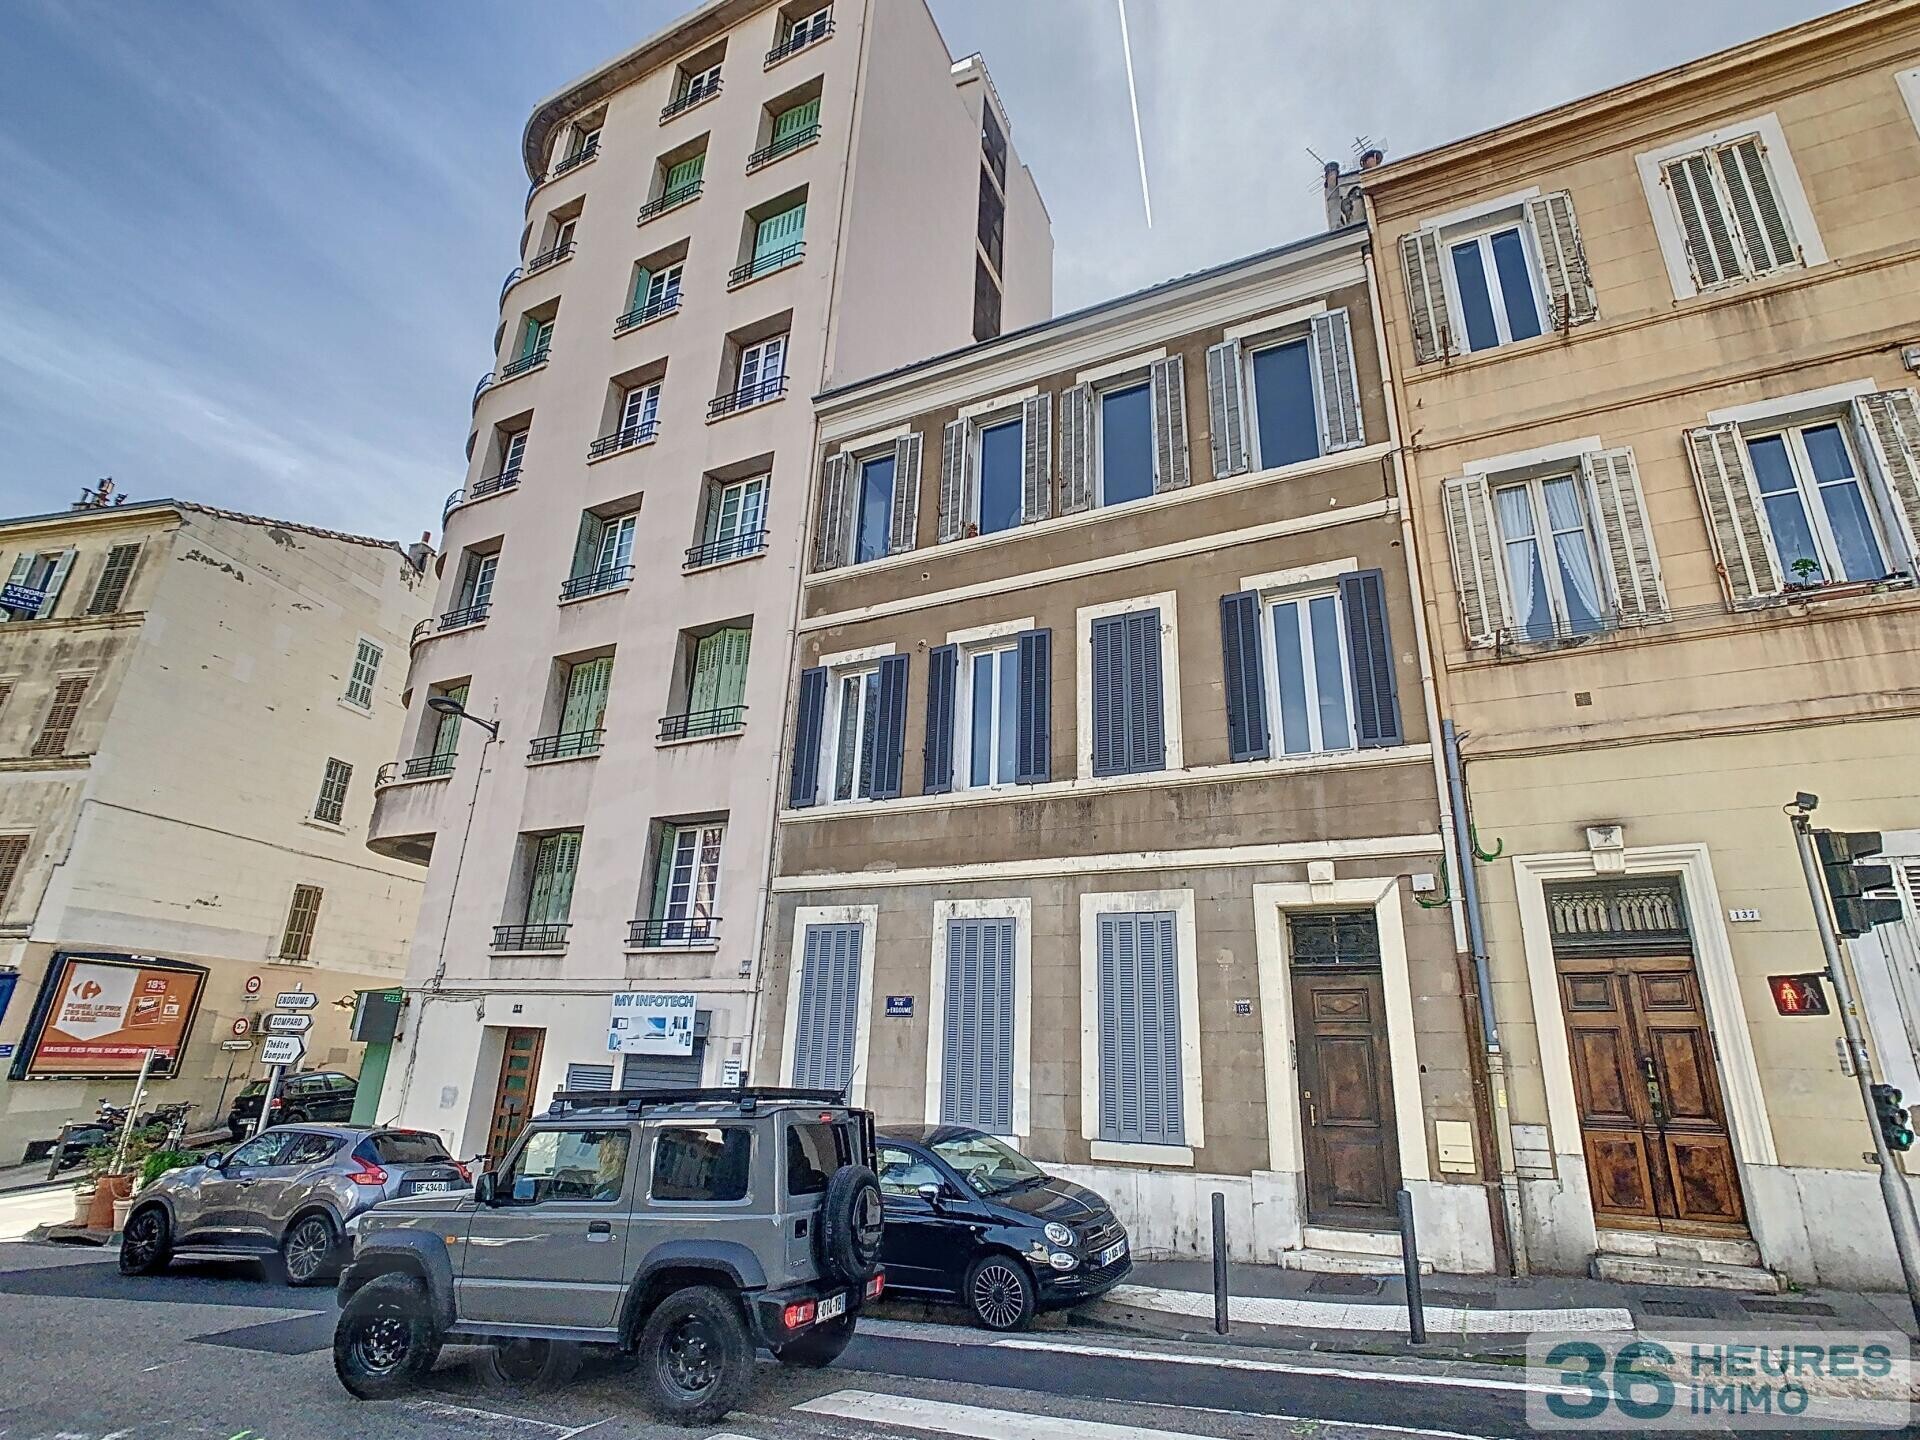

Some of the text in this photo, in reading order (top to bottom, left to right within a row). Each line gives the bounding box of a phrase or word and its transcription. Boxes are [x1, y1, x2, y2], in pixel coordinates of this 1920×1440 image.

[13, 586, 46, 598] VENDRE
[1734, 910, 1755, 919] 137
[278, 996, 309, 1005] ENDOUME
[614, 994, 695, 1008] MY INFOTECH
[81, 1010, 121, 1018] SAUCISSES
[272, 1017, 303, 1026] BOMPARD
[266, 1039, 290, 1049] Théâtre
[263, 1050, 293, 1061] Bompard
